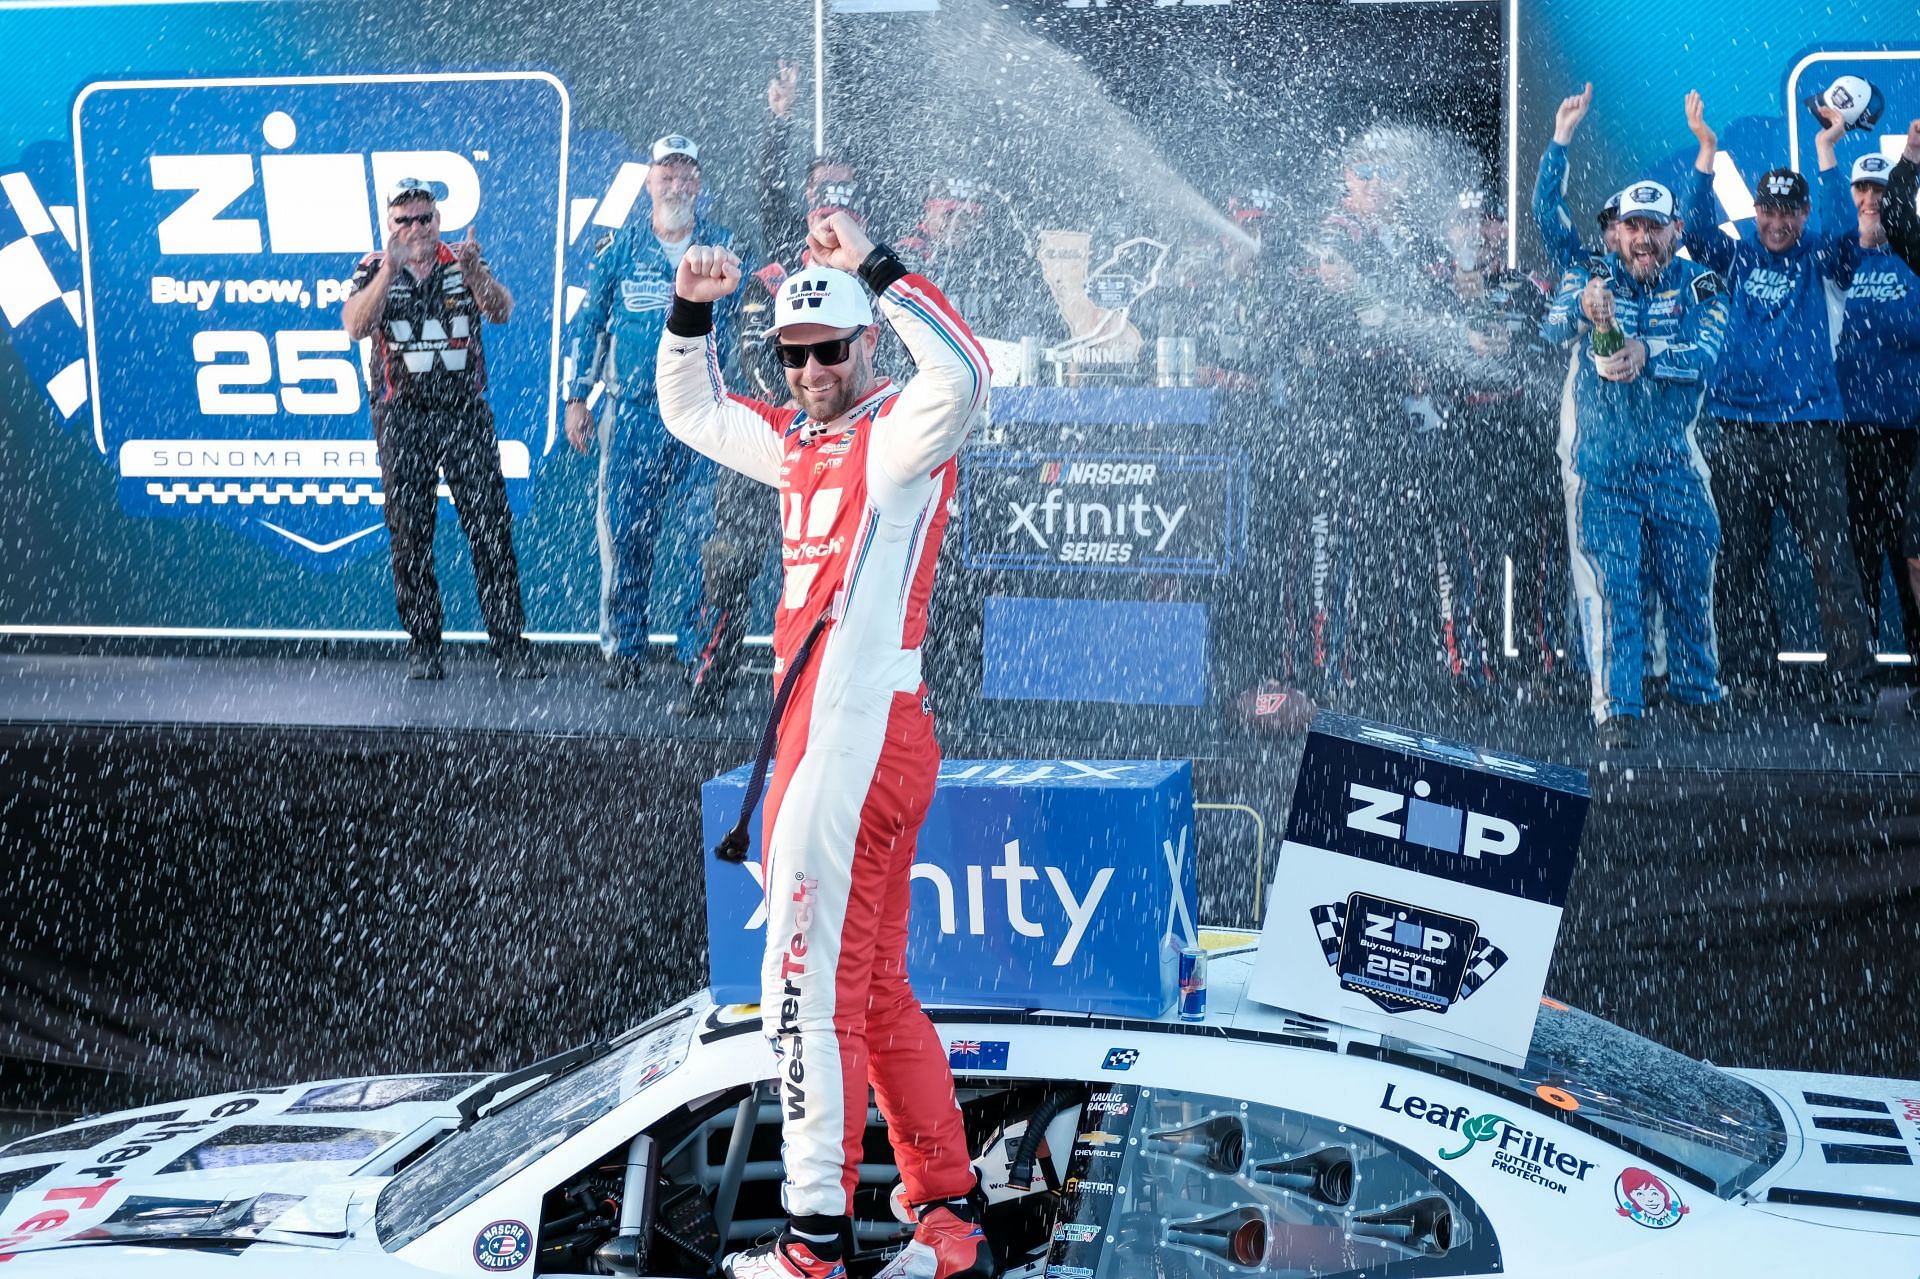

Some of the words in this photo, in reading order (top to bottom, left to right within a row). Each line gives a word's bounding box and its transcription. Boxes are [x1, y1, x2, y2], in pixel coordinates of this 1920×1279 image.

[151, 276, 221, 311] Buy
[224, 279, 311, 309] now,
[317, 279, 354, 309] pa
[193, 330, 373, 415] 25
[154, 451, 301, 467] SONOMA
[1066, 463, 1157, 485] NASCAR
[1007, 488, 1188, 551] xfinity
[782, 537, 841, 560] erTech
[1059, 542, 1133, 562] SERIES
[743, 838, 1116, 967] nity
[1360, 939, 1379, 950] Buy
[1380, 945, 1402, 957] now,
[1403, 950, 1422, 961] pay
[1423, 953, 1447, 966] later
[1366, 953, 1432, 988] 250
[777, 879, 818, 1121] WeaherTech
[1351, 976, 1391, 990] SONOMA
[1395, 987, 1442, 1003] RACEWAY
[1087, 1102, 1121, 1112] RACING
[1091, 1092, 1123, 1102] KAULIG
[1379, 1083, 1470, 1132] Leaf
[1497, 1123, 1595, 1182] Filter
[1074, 1149, 1122, 1159] CHEVROLET
[1494, 1150, 1542, 1175] GUTTER
[1491, 1159, 1568, 1195] PROTECTION
[483, 1224, 525, 1241] NASCAR
[479, 1250, 524, 1267] SALUTES
